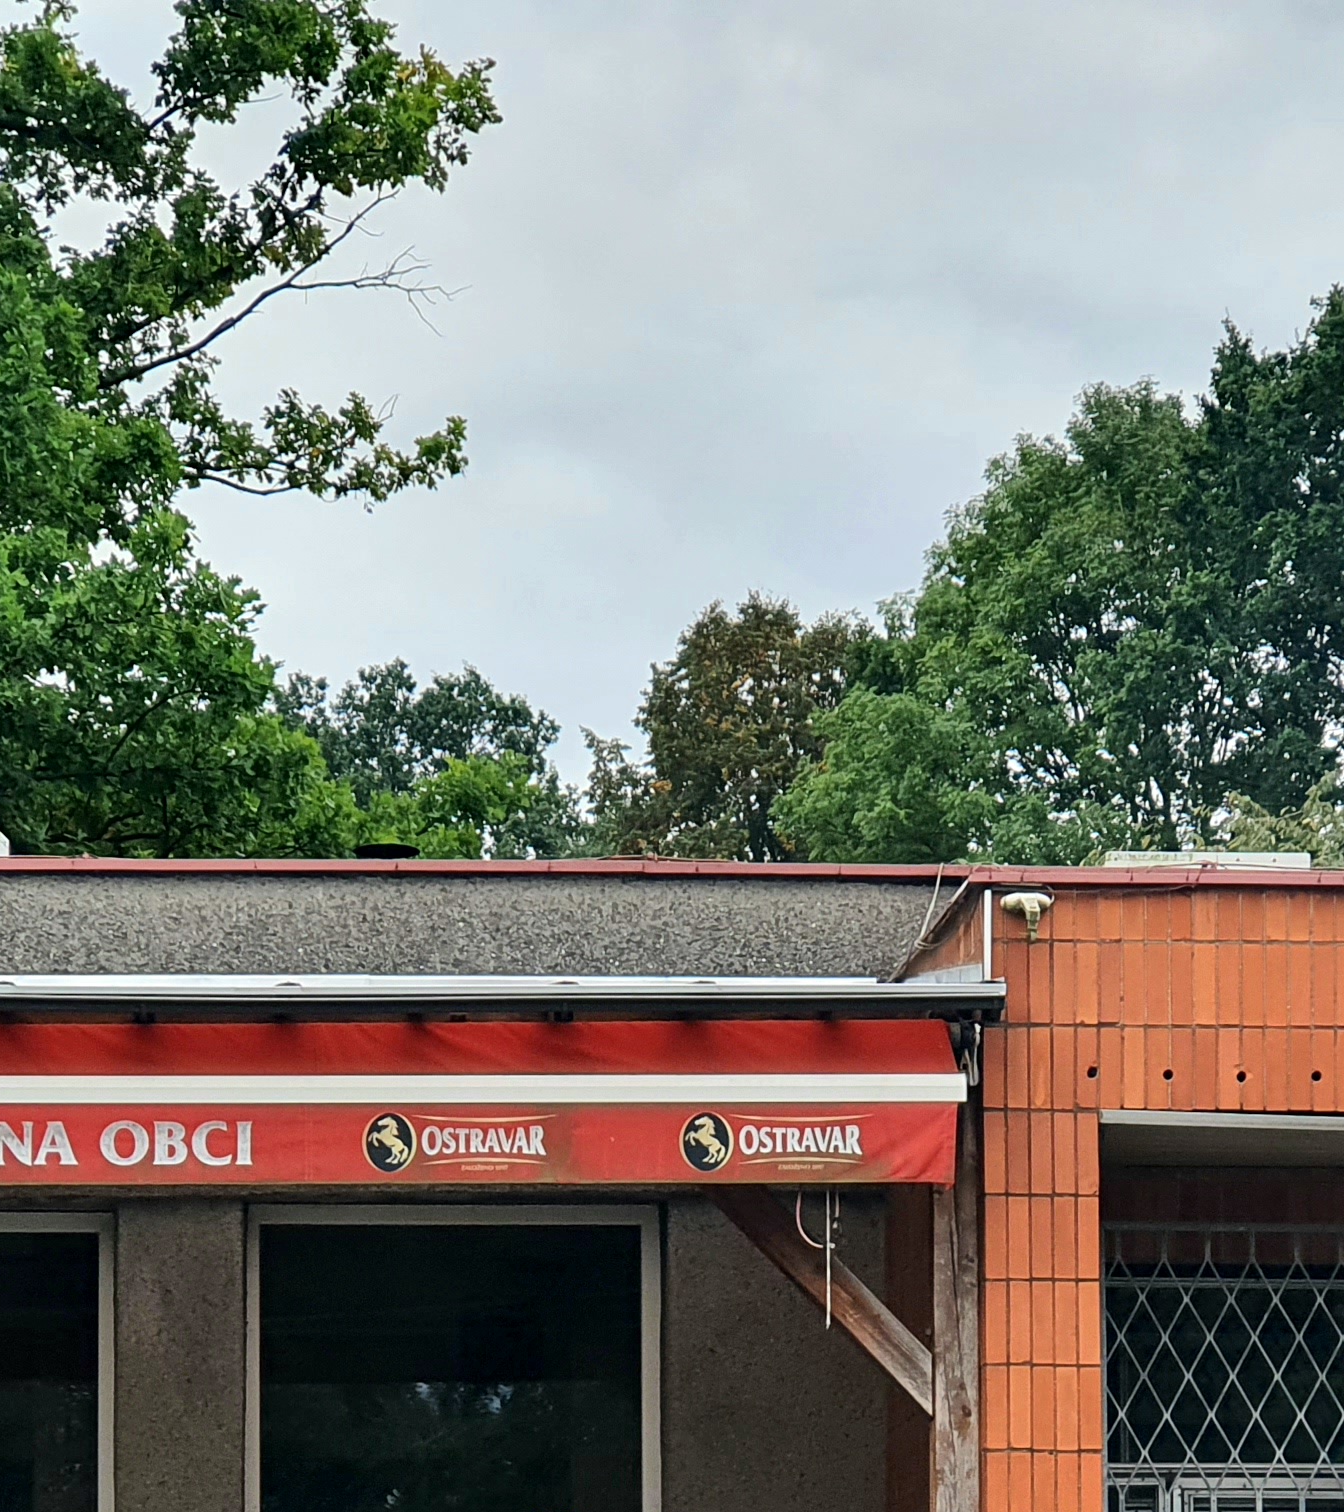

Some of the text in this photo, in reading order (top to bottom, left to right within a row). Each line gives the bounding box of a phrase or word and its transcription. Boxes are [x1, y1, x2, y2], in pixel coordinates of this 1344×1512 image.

[99, 1119, 254, 1167] OBCI
[421, 1125, 547, 1156] OSTRAVAR
[739, 1124, 863, 1155] OSTRAVAR
